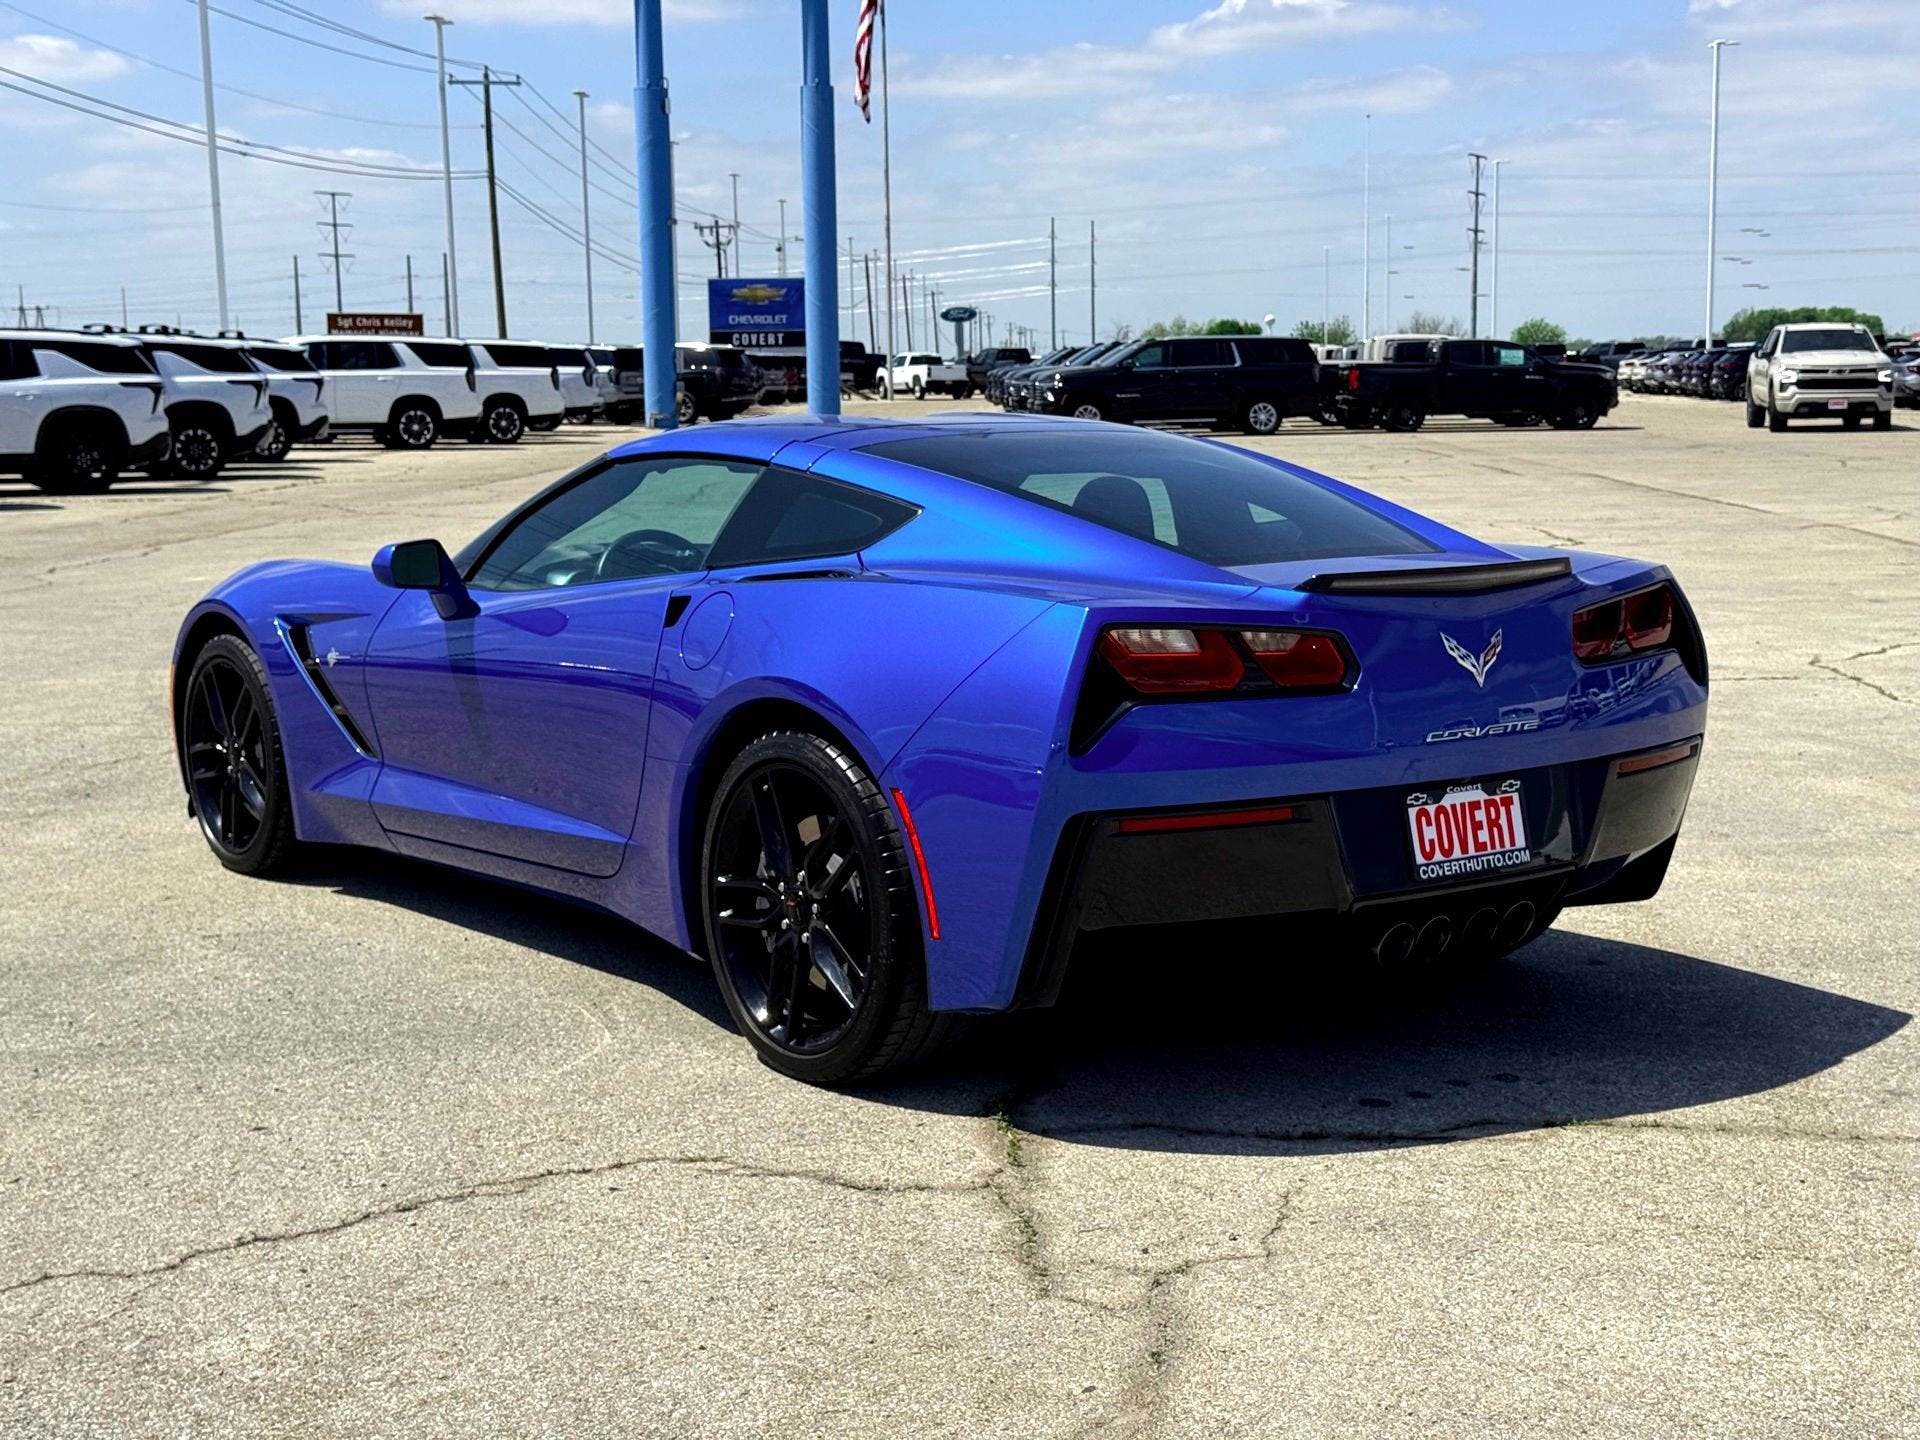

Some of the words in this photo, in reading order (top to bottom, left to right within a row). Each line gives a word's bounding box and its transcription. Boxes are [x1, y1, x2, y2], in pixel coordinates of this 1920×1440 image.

[336, 316, 354, 329] Sgt
[355, 316, 382, 327] Chris
[728, 314, 788, 325] CHEVROLET
[732, 333, 784, 346] COVERT
[1426, 720, 1538, 742] CORVETTE
[1446, 783, 1482, 794] Covert
[1415, 795, 1516, 862] COVERT
[1420, 849, 1531, 879] COVERTHUTTO.COM
